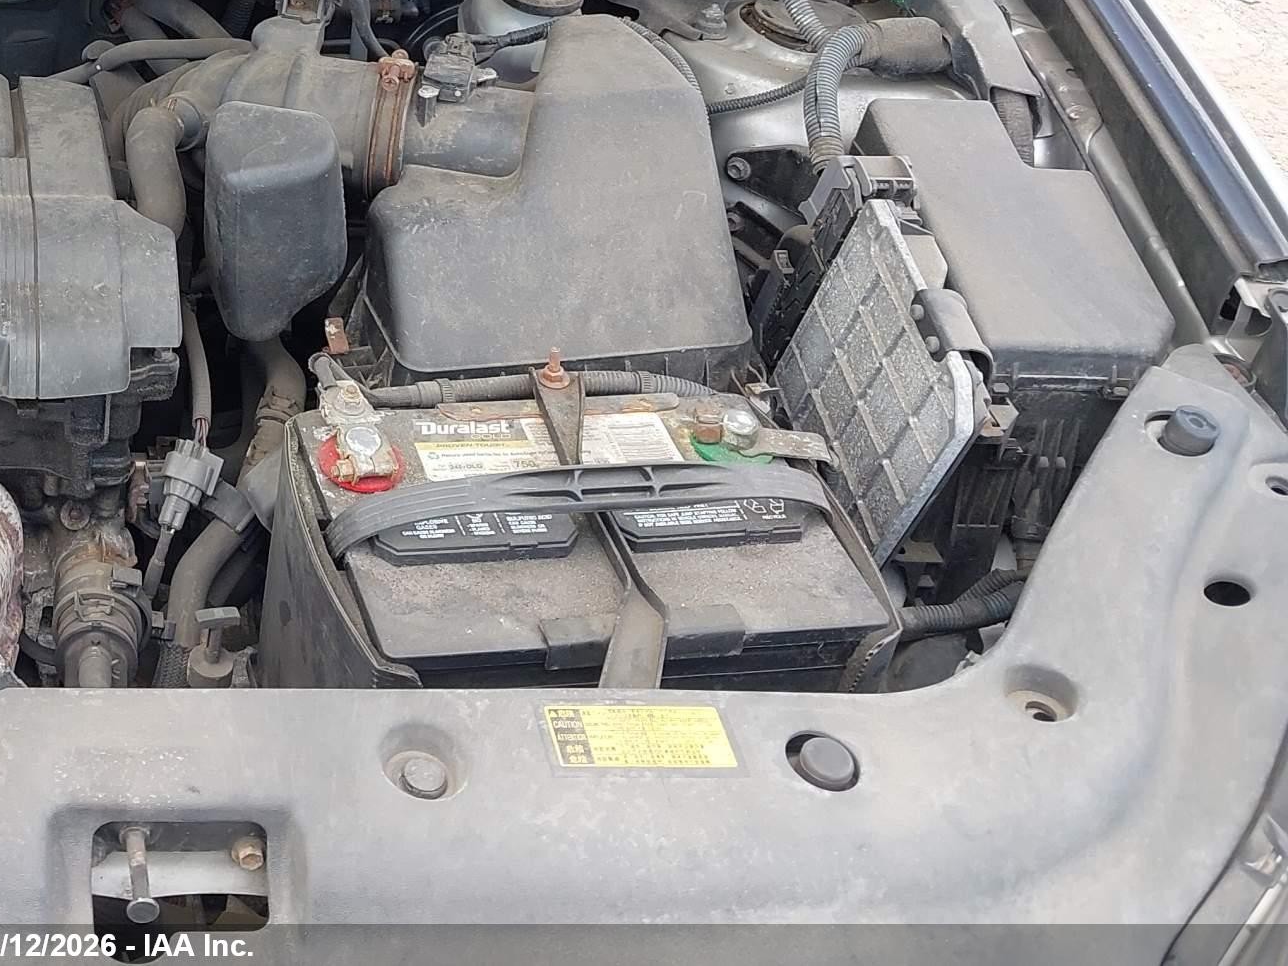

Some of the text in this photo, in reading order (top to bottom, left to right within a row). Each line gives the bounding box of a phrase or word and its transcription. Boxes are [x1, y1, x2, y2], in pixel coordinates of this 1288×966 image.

[415, 420, 511, 435] Duralast
[512, 459, 537, 469] 750
[552, 719, 584, 729] CAUTION
